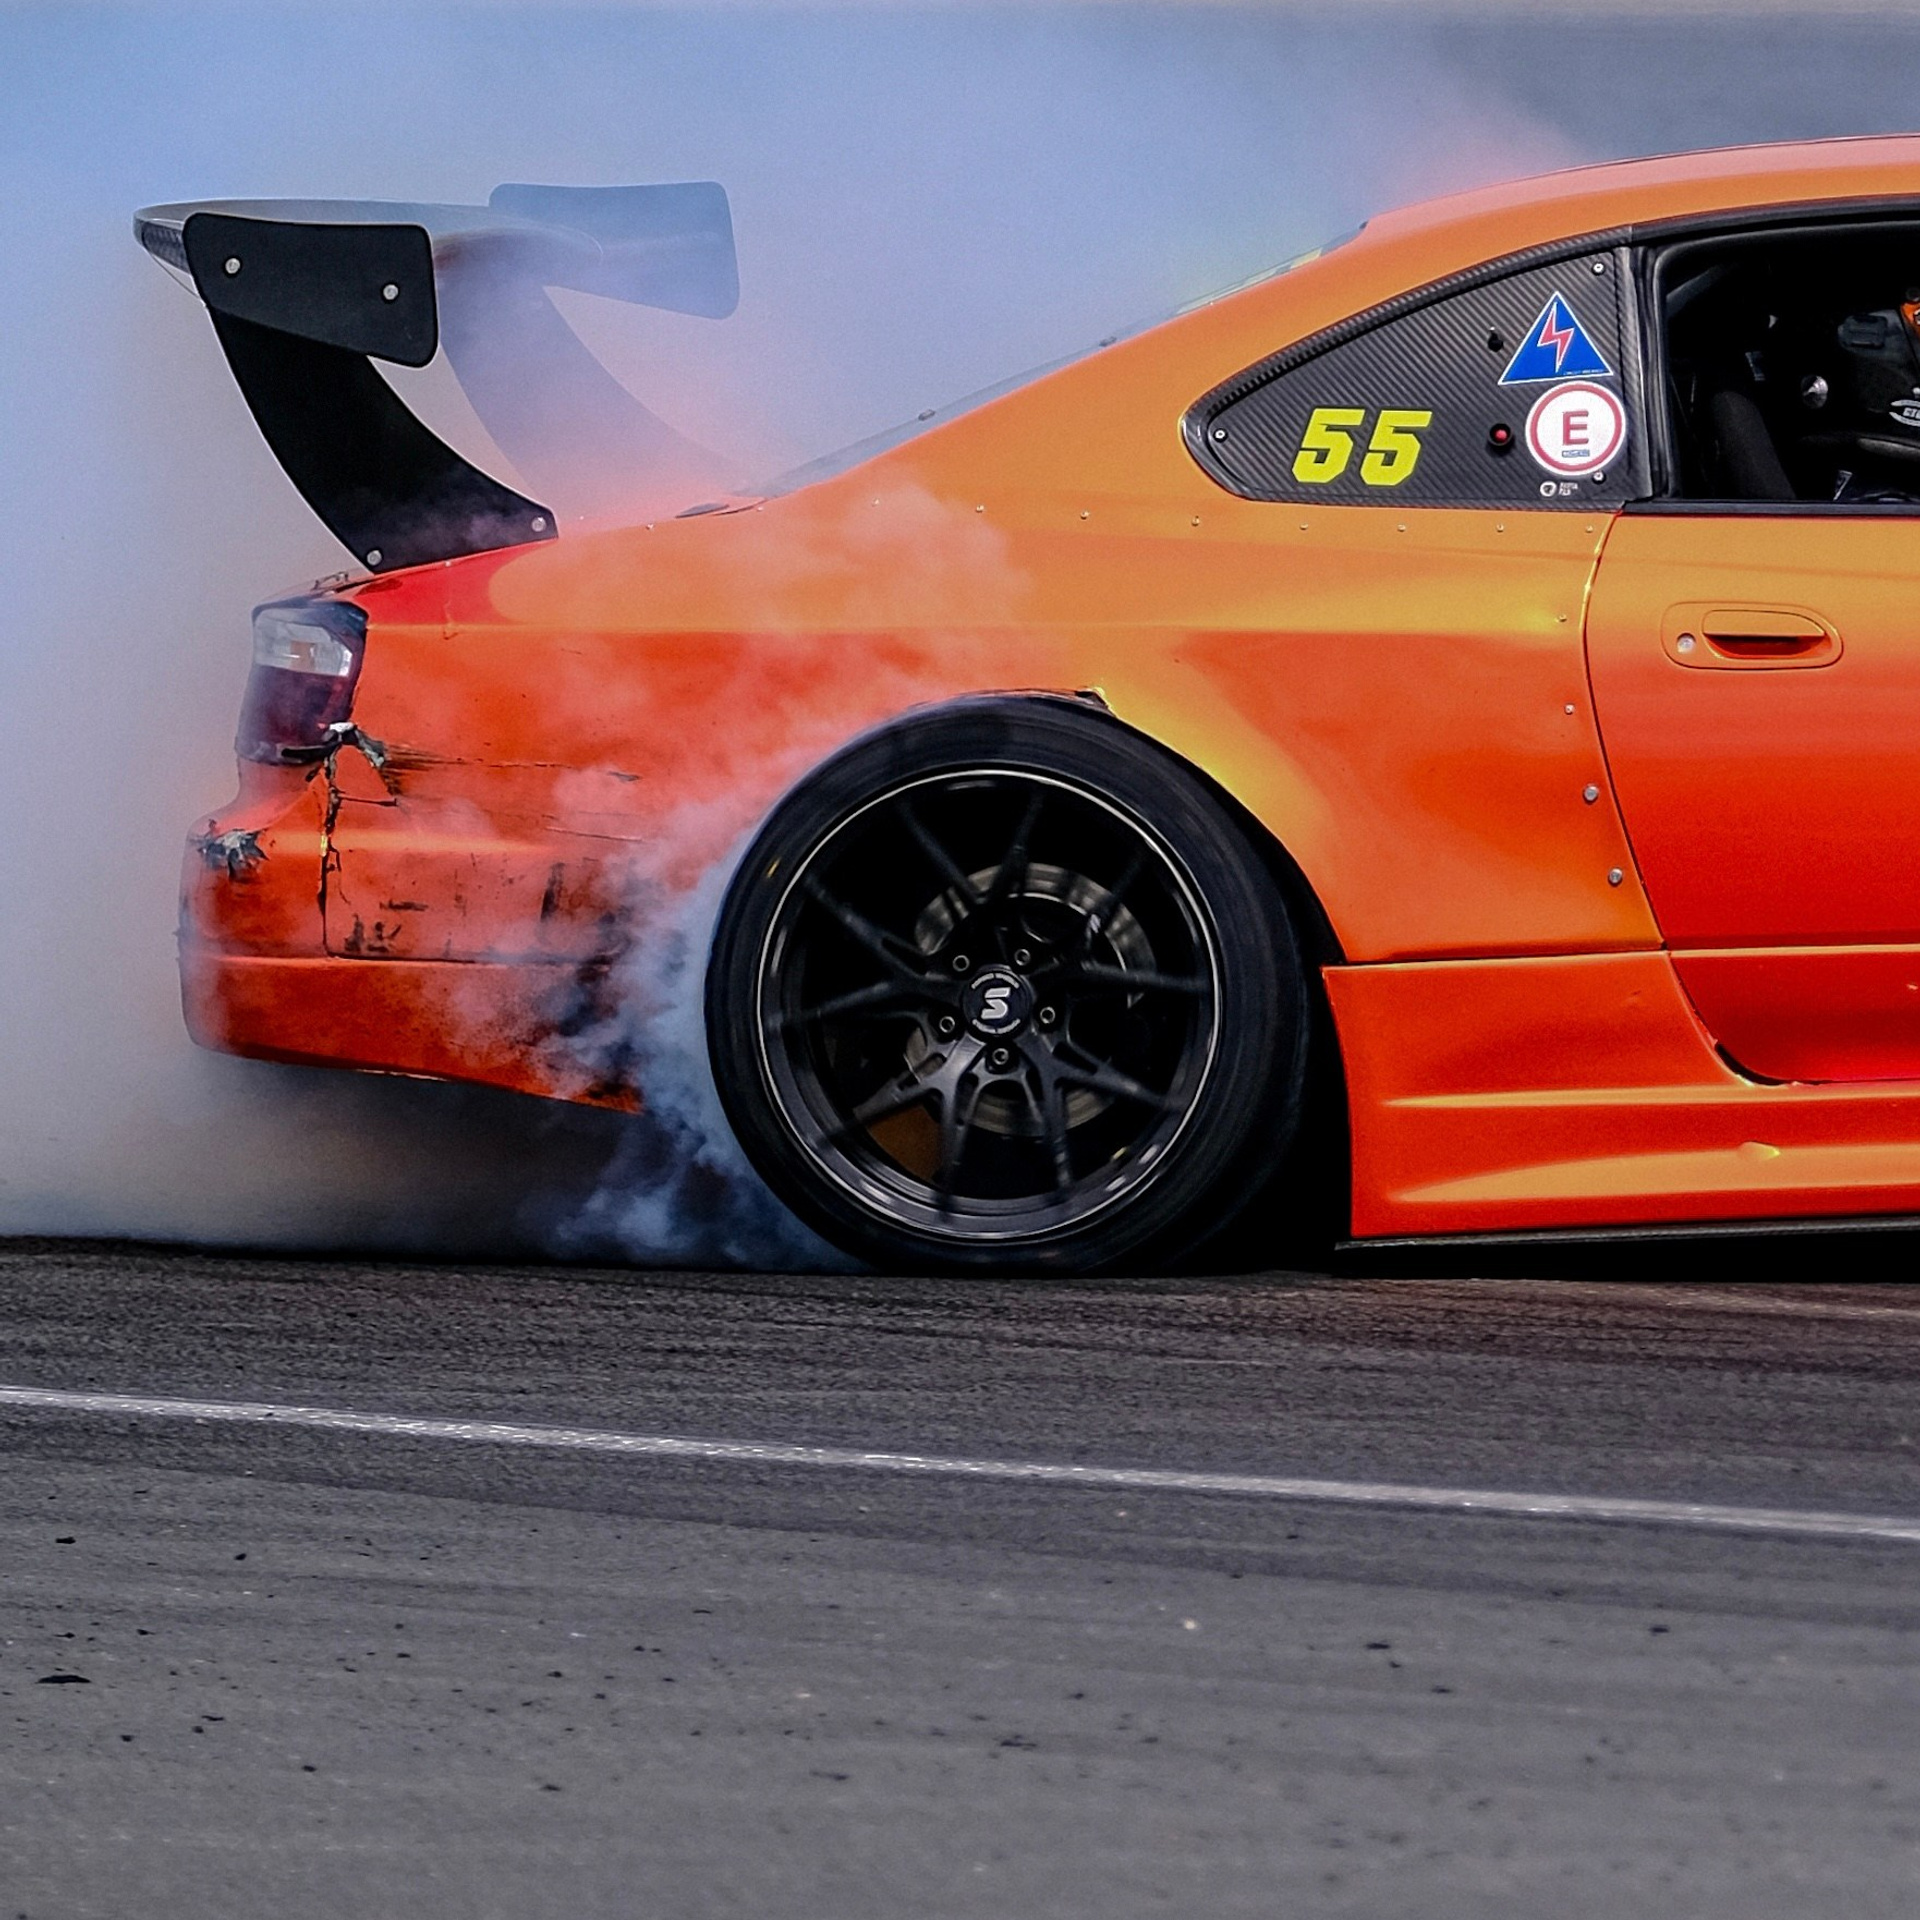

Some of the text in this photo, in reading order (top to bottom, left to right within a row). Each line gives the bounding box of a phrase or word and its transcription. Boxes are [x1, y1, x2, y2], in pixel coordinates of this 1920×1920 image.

[1562, 410, 1589, 446] E
[1291, 407, 1433, 486] 55
[981, 987, 1011, 1020] S
